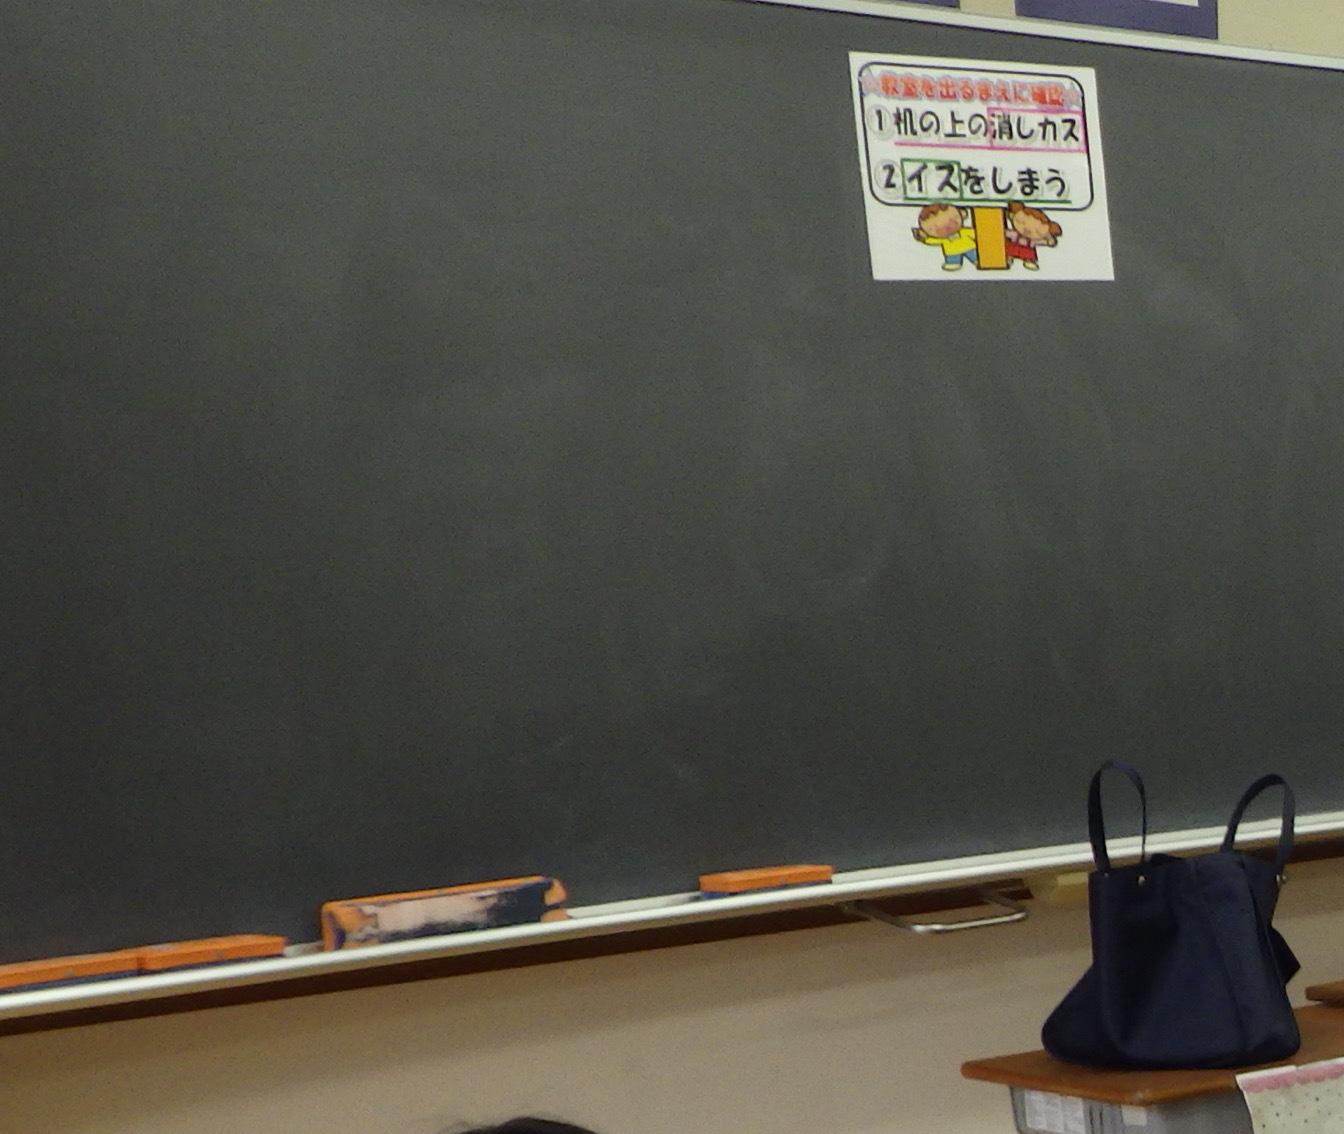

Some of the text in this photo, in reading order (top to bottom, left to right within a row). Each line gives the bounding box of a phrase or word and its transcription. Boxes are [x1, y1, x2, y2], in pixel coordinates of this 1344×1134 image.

[894, 107, 1080, 143] 机の上の消しカス
[906, 162, 1070, 198] イスをしまう
